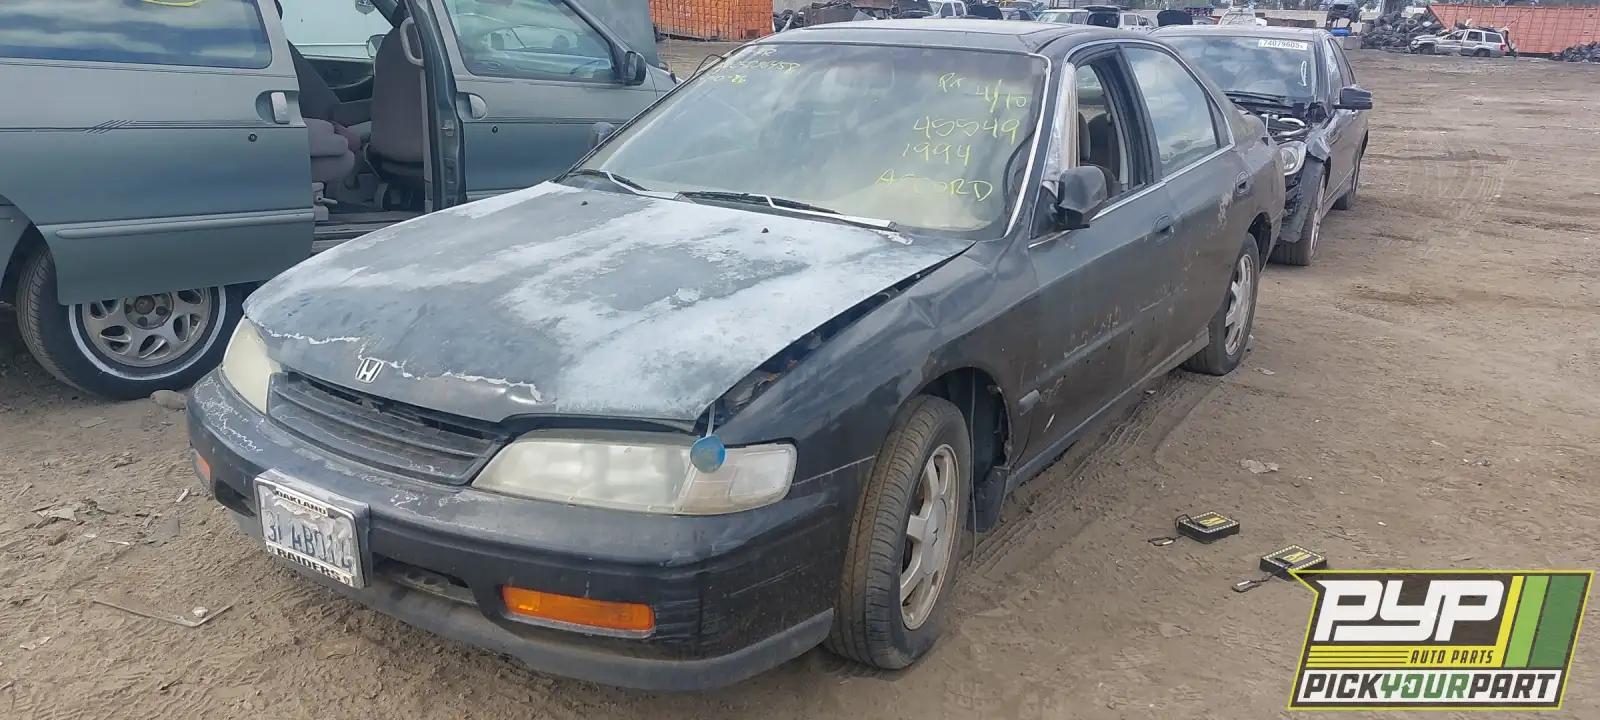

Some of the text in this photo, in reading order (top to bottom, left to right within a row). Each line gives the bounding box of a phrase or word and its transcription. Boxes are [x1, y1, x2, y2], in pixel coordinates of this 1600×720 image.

[902, 142, 972, 166] 1994
[276, 490, 328, 515] OAKLAND
[276, 548, 342, 582] RAIDERS
